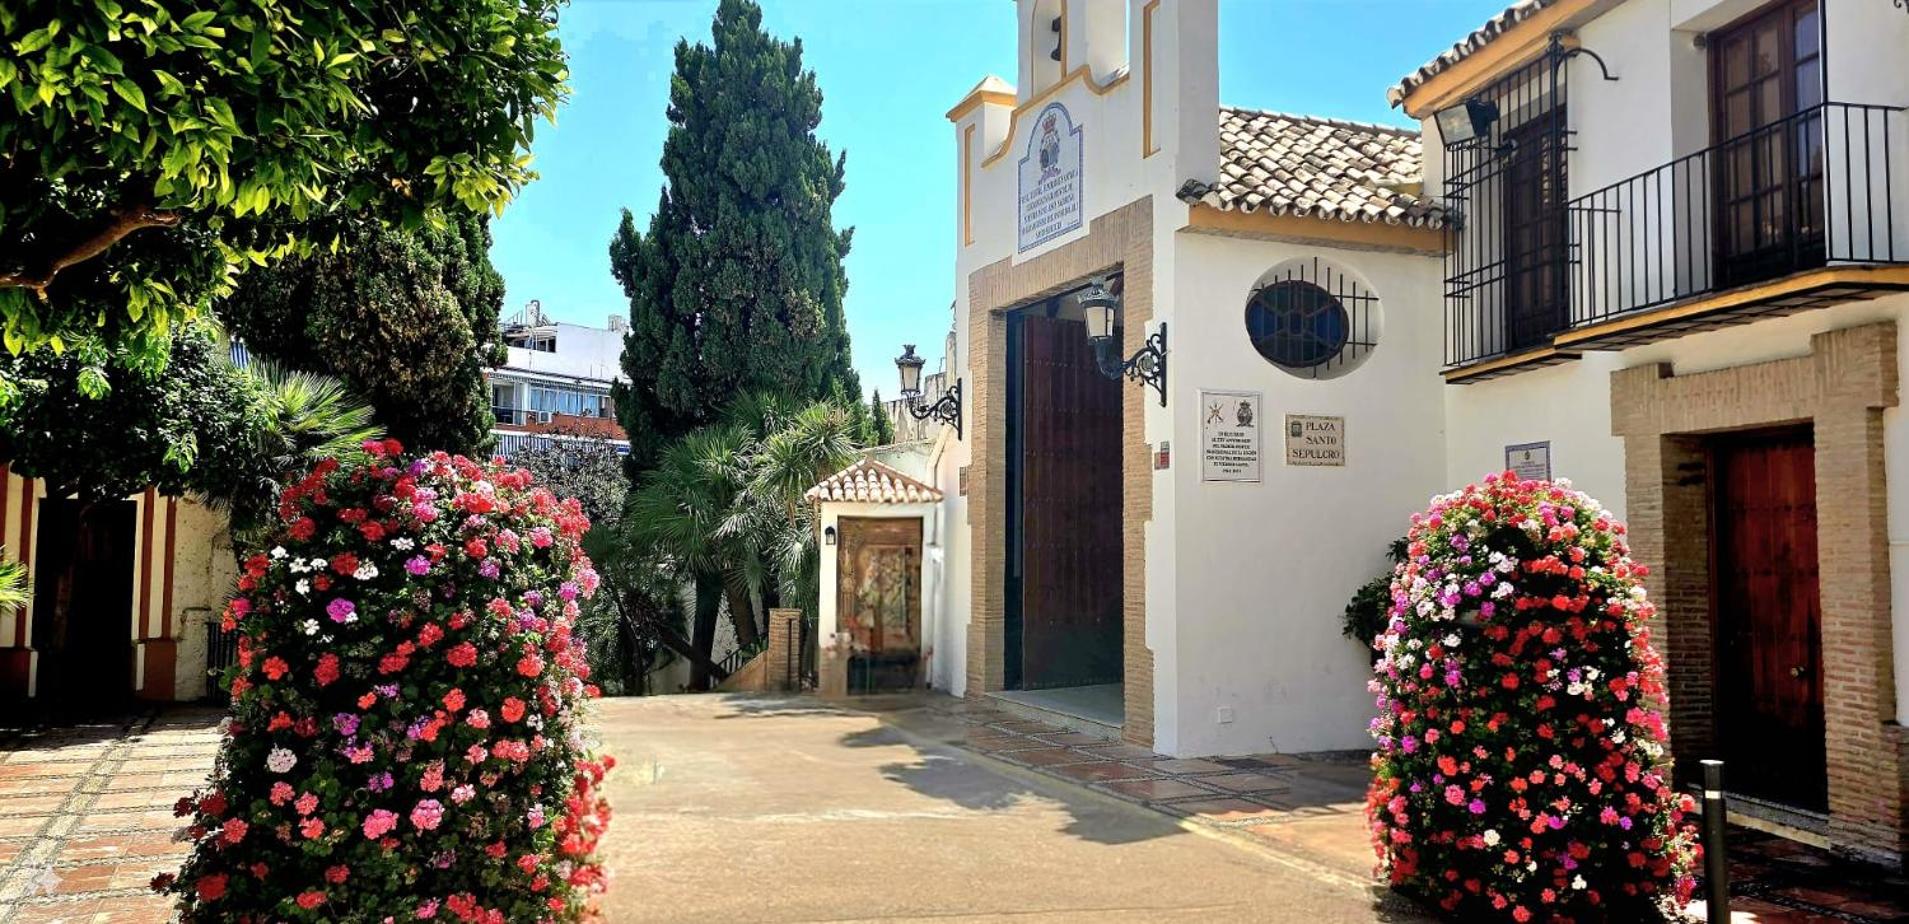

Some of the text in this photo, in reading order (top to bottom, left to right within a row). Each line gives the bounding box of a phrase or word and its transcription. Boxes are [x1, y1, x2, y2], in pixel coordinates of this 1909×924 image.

[1306, 421, 1335, 431] PLAZA
[1306, 435, 1337, 445] SANTO
[1292, 449, 1340, 459] SEPULCRO
